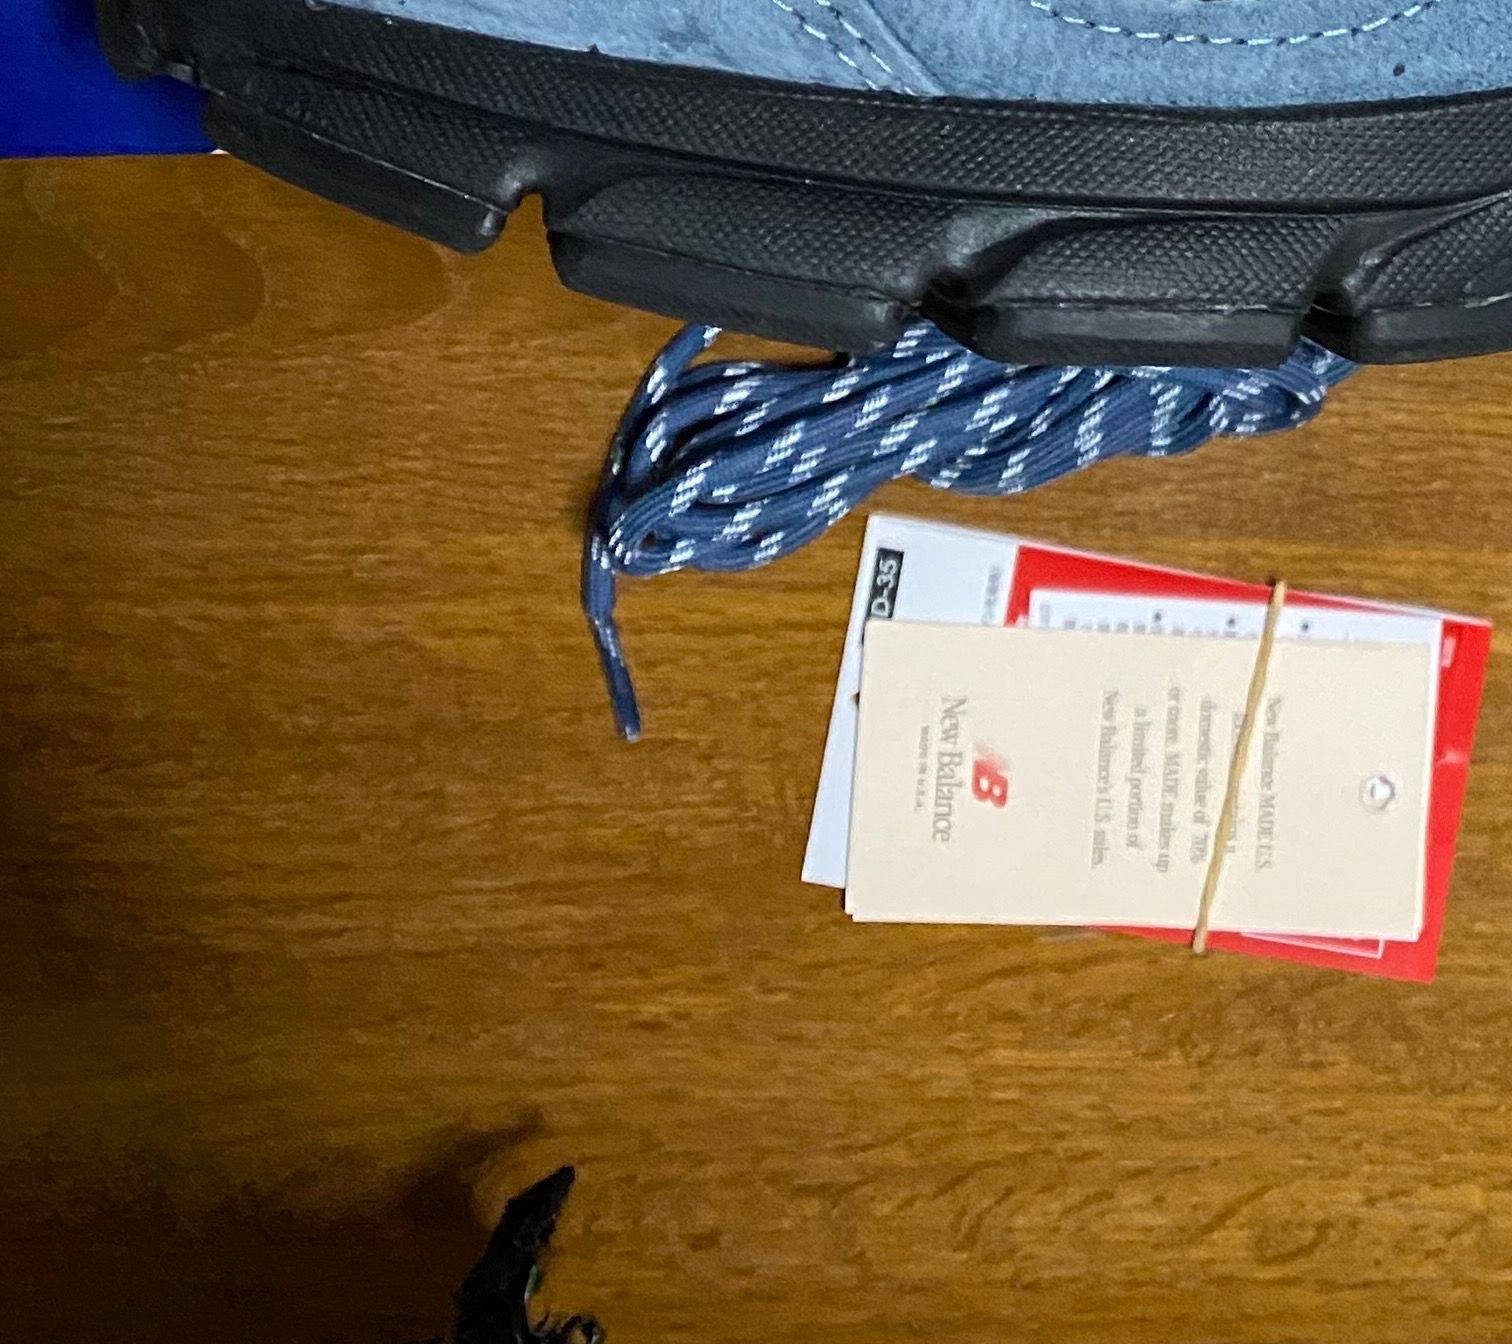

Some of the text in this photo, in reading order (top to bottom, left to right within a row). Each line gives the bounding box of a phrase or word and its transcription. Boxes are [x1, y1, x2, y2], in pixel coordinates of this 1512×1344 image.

[932, 696, 968, 843] New Balance
[1258, 794, 1278, 841] MADE
